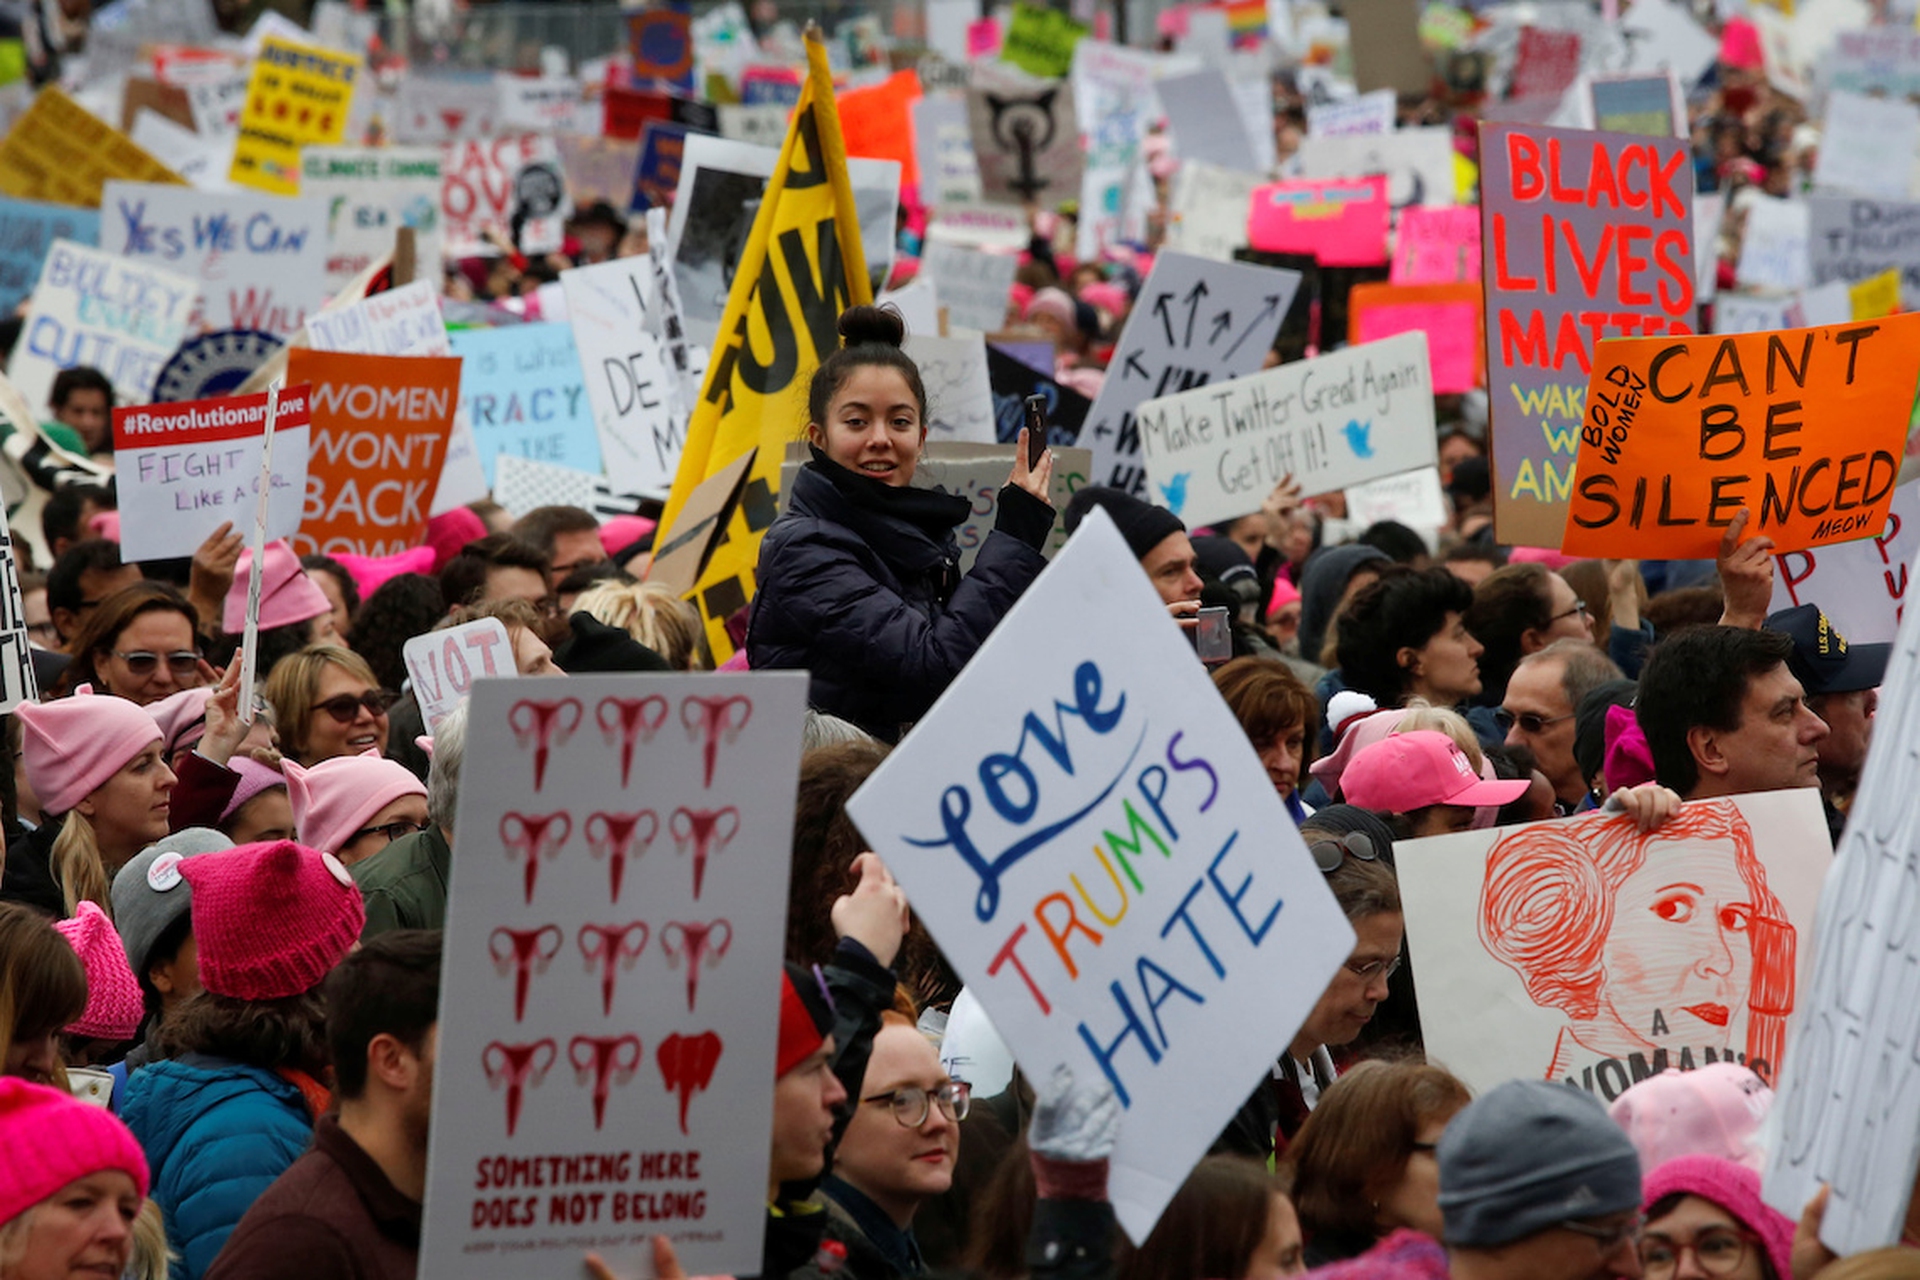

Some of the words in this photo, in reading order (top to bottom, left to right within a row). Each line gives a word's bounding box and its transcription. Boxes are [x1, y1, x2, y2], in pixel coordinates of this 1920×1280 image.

[1505, 132, 1687, 220] BLACK
[1493, 212, 1694, 317] LIVES
[1648, 325, 1880, 404] CAN'T
[310, 381, 449, 421] WOMEN
[1142, 404, 1214, 457] Make
[1212, 386, 1295, 439] Twitter
[1302, 370, 1355, 414] Great
[1364, 360, 1420, 416] Again
[1510, 382, 1590, 419] WAK
[1581, 364, 1631, 449] BOLD
[1600, 371, 1648, 465] WOMEN
[308, 428, 441, 470] WON'T
[1700, 400, 1803, 461] BE
[138, 449, 245, 484] FIGHT
[233, 486, 246, 501] A
[251, 477, 292, 496] GRL
[1217, 447, 1263, 495] Get
[1573, 449, 1897, 531] SILENCED
[302, 478, 429, 527] BACK
[1811, 510, 1873, 540] MEOW
[407, 628, 500, 706] NOT
[987, 730, 1219, 1016] TRUMPS
[1077, 830, 1284, 1110] HATE
[1652, 1008, 1670, 1036] A
[475, 1152, 632, 1191] SOMETHING
[638, 1150, 702, 1182] HERE
[471, 1197, 539, 1230] DOES
[549, 1194, 607, 1226] NOT
[612, 1191, 708, 1223] BELONG
